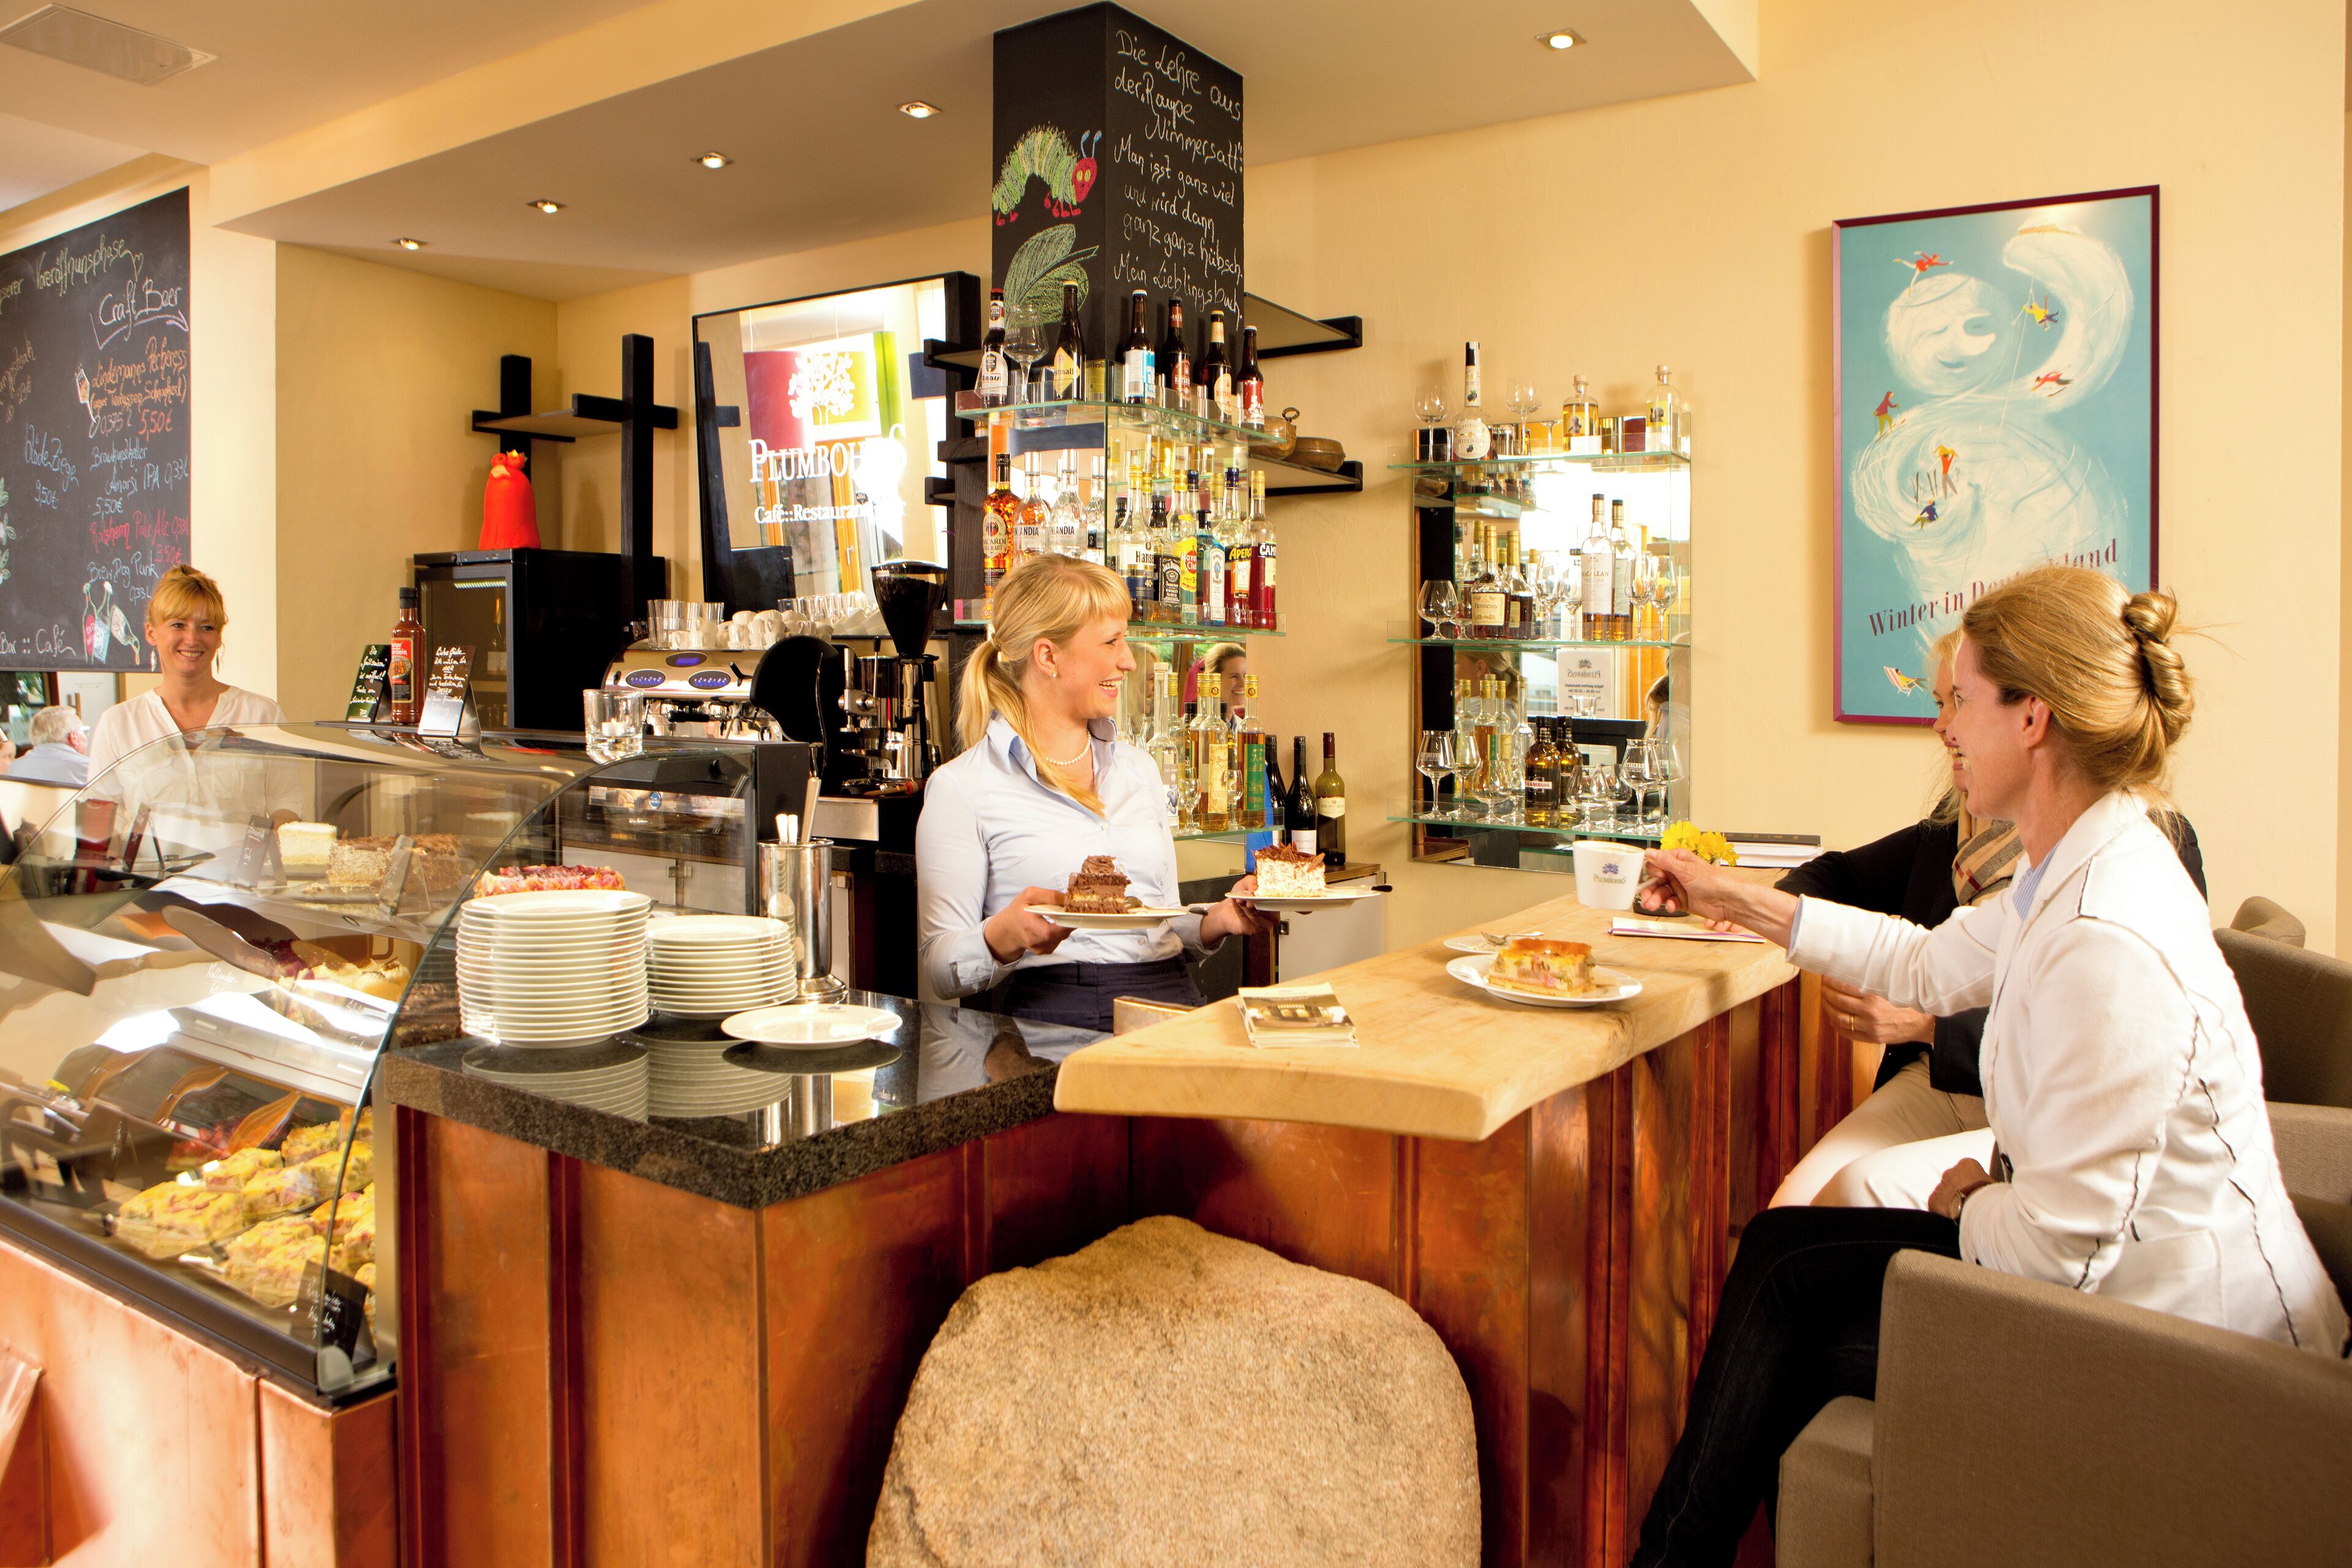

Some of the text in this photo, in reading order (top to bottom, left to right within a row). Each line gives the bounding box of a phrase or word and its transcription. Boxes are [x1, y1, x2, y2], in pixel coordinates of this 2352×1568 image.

[1115, 66, 1142, 99] der
[1116, 30, 1241, 121] Die Lehre aus
[1114, 134, 1234, 208] Man isst ganz viel
[1125, 184, 1146, 208] und
[1152, 192, 1178, 216] wird
[1114, 251, 1147, 286] Mein
[1123, 214, 1243, 286] ganz ganz hübsch.
[99, 276, 183, 342] Craft Beer
[143, 462, 160, 490] IPA
[1868, 537, 2120, 636] Winter in Deland
[36, 624, 76, 657] Café
